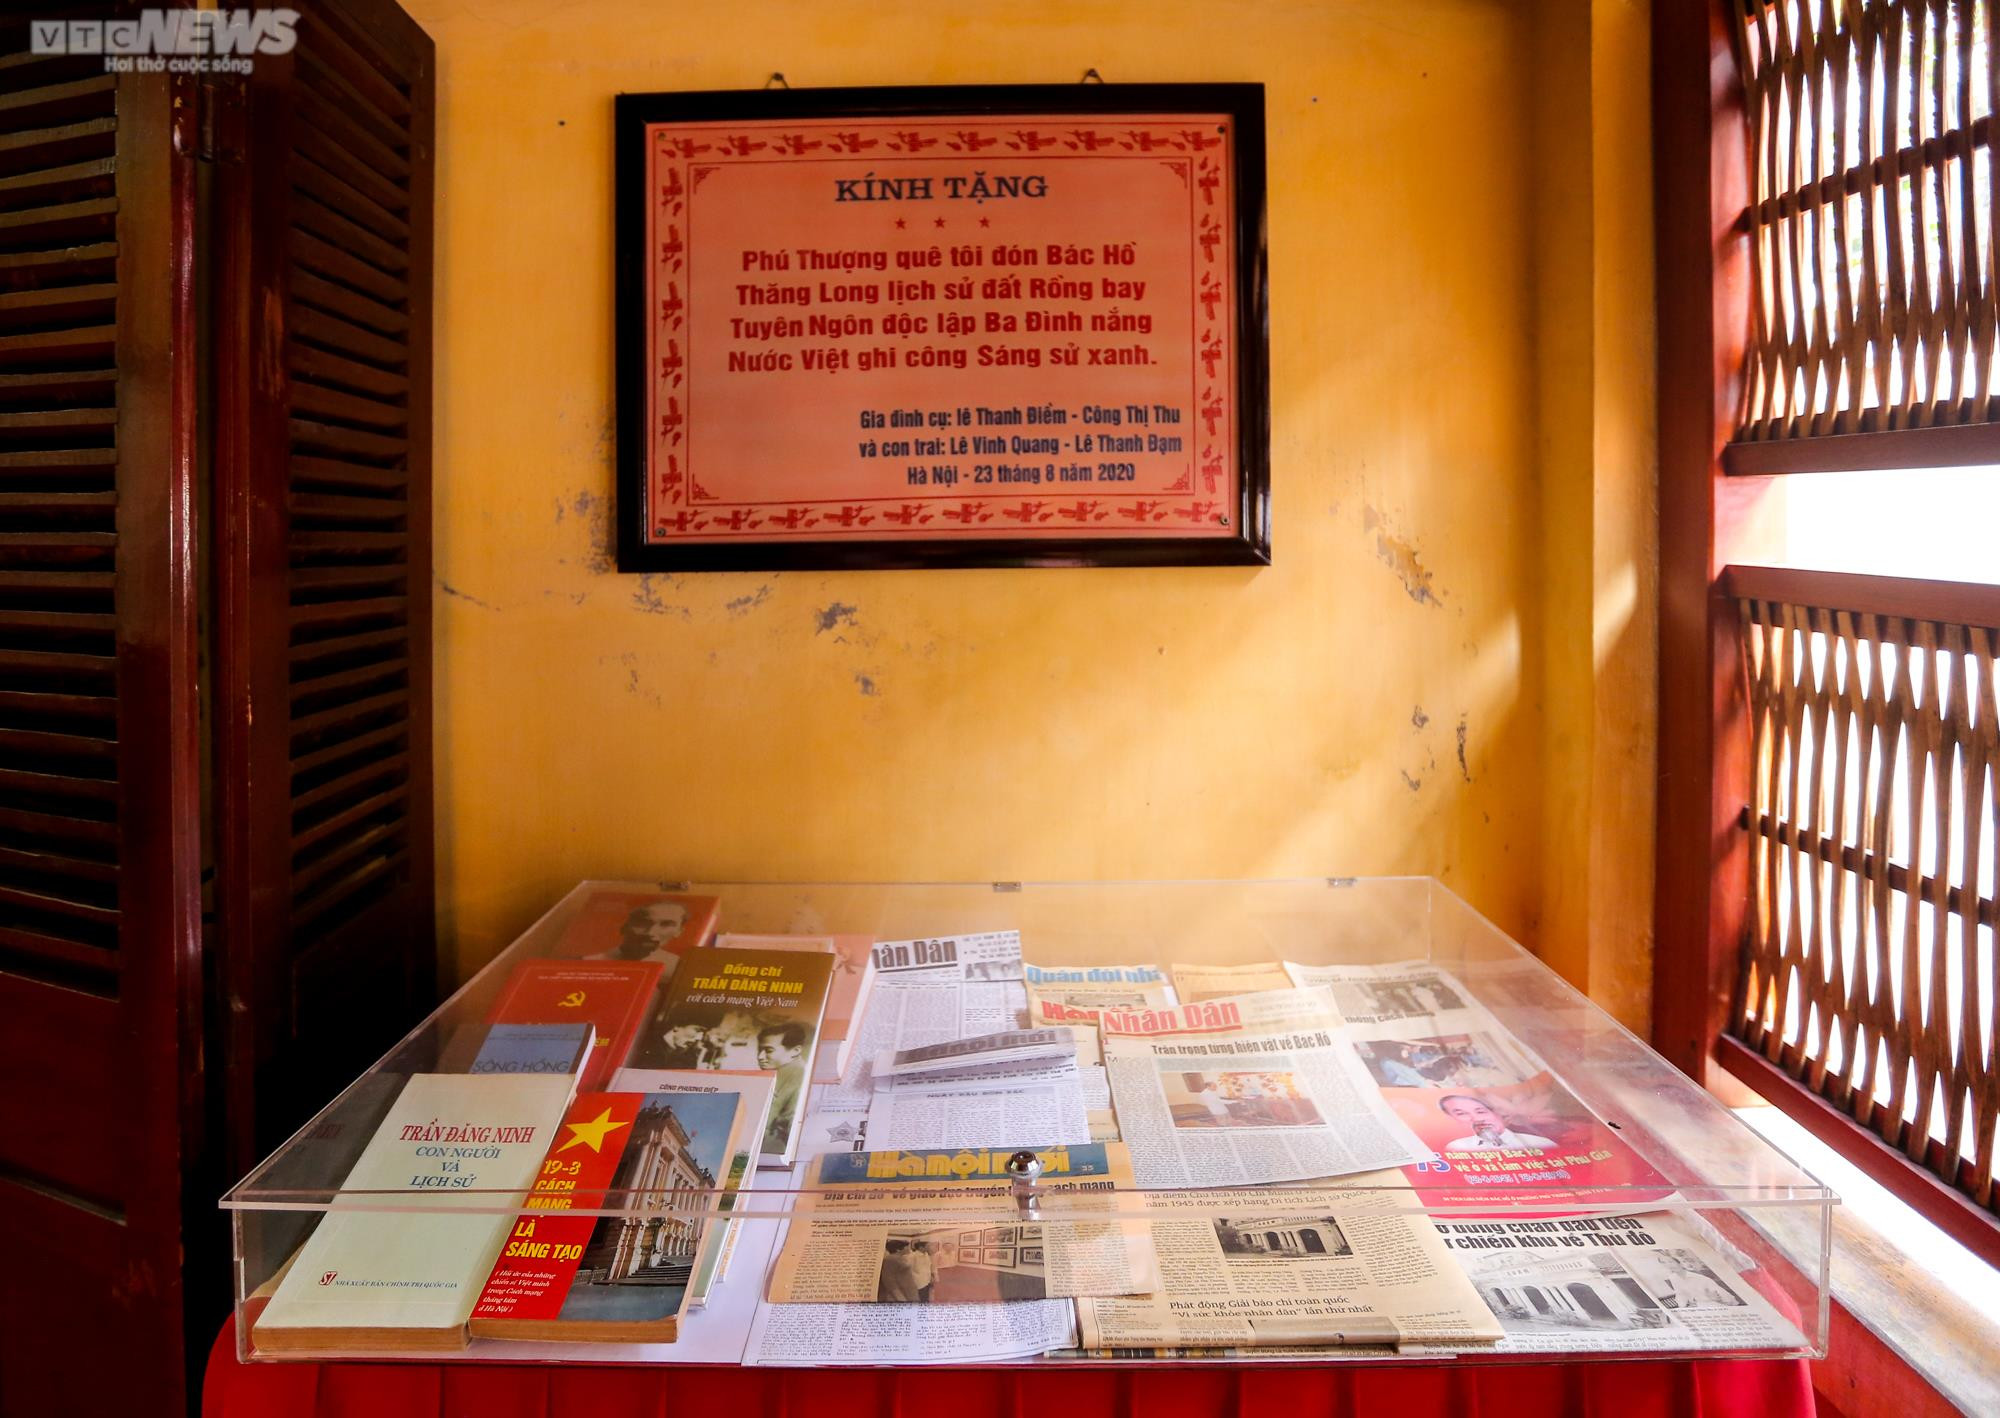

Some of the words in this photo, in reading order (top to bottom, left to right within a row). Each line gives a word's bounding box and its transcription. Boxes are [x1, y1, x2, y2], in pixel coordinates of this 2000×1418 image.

[835, 174, 933, 202] KÍNH
[943, 173, 1049, 204] TẶNG
[742, 249, 789, 271] Phú
[797, 249, 887, 274] Thượng
[897, 246, 942, 271] quê
[950, 245, 982, 266] tôi
[992, 245, 1038, 266] đón
[1047, 244, 1094, 266] Bác
[1104, 242, 1137, 266] Hồ
[737, 283, 810, 306] Thăng
[820, 282, 879, 304] Long
[888, 281, 935, 305] lịch
[944, 277, 975, 300] sử
[982, 274, 1022, 299] đất
[1030, 274, 1093, 300] Rồng
[1102, 277, 1146, 300] bay
[731, 317, 804, 340] Tuyên
[809, 314, 873, 338] Ngôn
[882, 313, 929, 339] độc
[937, 312, 976, 337] lập
[985, 312, 1017, 332] Ba
[1026, 310, 1083, 332] Đình
[1091, 307, 1152, 334] nắng
[729, 348, 792, 372] Nước
[801, 347, 849, 373] Việt
[858, 347, 896, 371] ghi
[905, 346, 967, 369] công
[978, 344, 1041, 369] Sáng
[1050, 342, 1080, 366] sử
[1088, 344, 1158, 366] xanh.
[860, 410, 885, 428] Gia
[891, 409, 924, 428] đình
[929, 411, 952, 430] cụ:
[976, 407, 1023, 426] Thanh
[1083, 405, 1121, 426] Công
[1126, 404, 1149, 427] Thị
[1153, 404, 1181, 424] Thu
[859, 439, 877, 458] và
[882, 441, 910, 456] con
[914, 437, 946, 456] trai:
[950, 436, 969, 455] Lê
[1011, 434, 1059, 455] Quang
[1076, 434, 1093, 452] Lê
[1097, 433, 1143, 452] Thanh
[1148, 434, 1182, 455] Đạm
[907, 466, 927, 485] Hà
[932, 465, 958, 488] Nội
[974, 465, 993, 483] 23
[998, 464, 1041, 485] tháng
[1045, 464, 1055, 482] 8
[1060, 463, 1093, 482] năm
[1098, 463, 1136, 482] 2020
[760, 966, 783, 977] chí
[693, 976, 728, 990] TRẦN
[730, 978, 768, 992] ĐĂNG
[769, 981, 804, 993] NINH
[703, 993, 725, 1004] cách
[776, 997, 798, 1007] Nam
[1103, 1006, 1178, 1033] Nhân
[1183, 1001, 1241, 1029] Dân
[1209, 1042, 1235, 1056] từng
[1236, 1039, 1261, 1054] hiện
[400, 1118, 446, 1141] TRẦN
[443, 1122, 492, 1143] ĐĂNG
[492, 1126, 537, 1144] NINH
[415, 1146, 450, 1158] CON
[450, 1145, 501, 1159] NGƯỜI
[441, 1159, 460, 1172] VÀ
[410, 1175, 450, 1189] LỊCH
[451, 1173, 477, 1188] SỬ
[534, 1177, 576, 1194] CÁCH
[1146, 1200, 1168, 1208] năm
[1196, 1198, 1220, 1208] được
[1222, 1197, 1241, 1207] xếp
[514, 1219, 536, 1238] LÀ
[1455, 1234, 1513, 1249] chiến
[1515, 1234, 1558, 1248] khu
[1558, 1234, 1585, 1247] về
[1585, 1231, 1627, 1246] Thủ
[1631, 1231, 1656, 1246] đô
[505, 1240, 551, 1259] SÁNG
[552, 1243, 583, 1262] TẠO
[1170, 1301, 1195, 1310] Phát
[1197, 1301, 1226, 1311] động
[1228, 1299, 1250, 1308] Giải
[1253, 1299, 1273, 1307] báo
[1276, 1298, 1292, 1306] chí
[1295, 1297, 1320, 1306] toàn
[1322, 1295, 1350, 1306] quốc
[1244, 1309, 1275, 1317] nhân
[1304, 1306, 1323, 1315] lần
[1325, 1305, 1346, 1315] thứ
[1347, 1304, 1375, 1314] nhất
